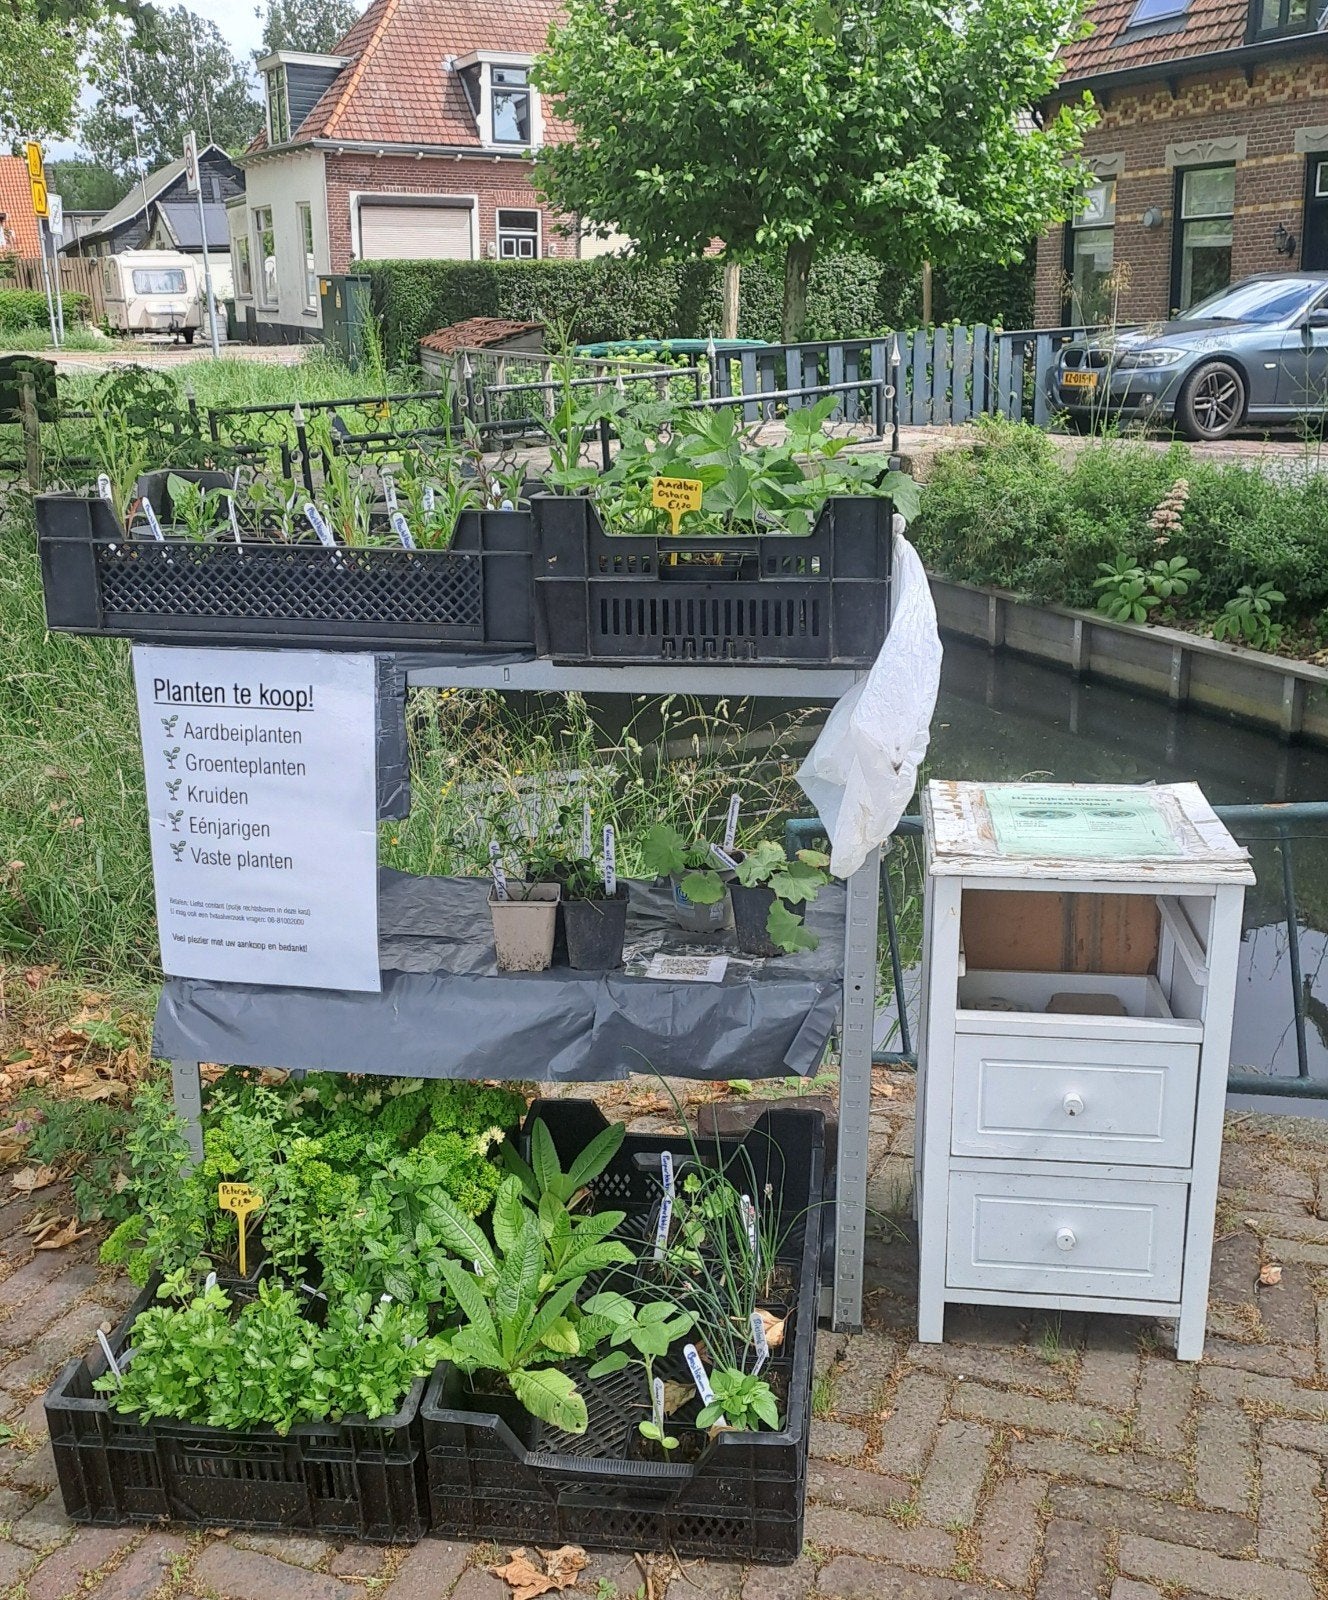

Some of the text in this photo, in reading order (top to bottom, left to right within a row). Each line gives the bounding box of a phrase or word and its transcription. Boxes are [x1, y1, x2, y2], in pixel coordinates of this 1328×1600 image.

[657, 480, 698, 491] Aardbei
[658, 490, 690, 500] Ostara
[154, 678, 313, 712] Planten te koop!
[184, 722, 302, 746] Aardbeiplanten
[186, 753, 306, 778] Groenteplanten
[188, 785, 248, 805] Kruiden
[190, 817, 270, 841] Eénjarigen
[191, 847, 293, 870] Vaste planten
[172, 932, 185, 942] Veel
[188, 936, 208, 945] plezier
[211, 938, 223, 946] met
[237, 940, 265, 951] aankoop
[279, 942, 307, 952] bedankt!
